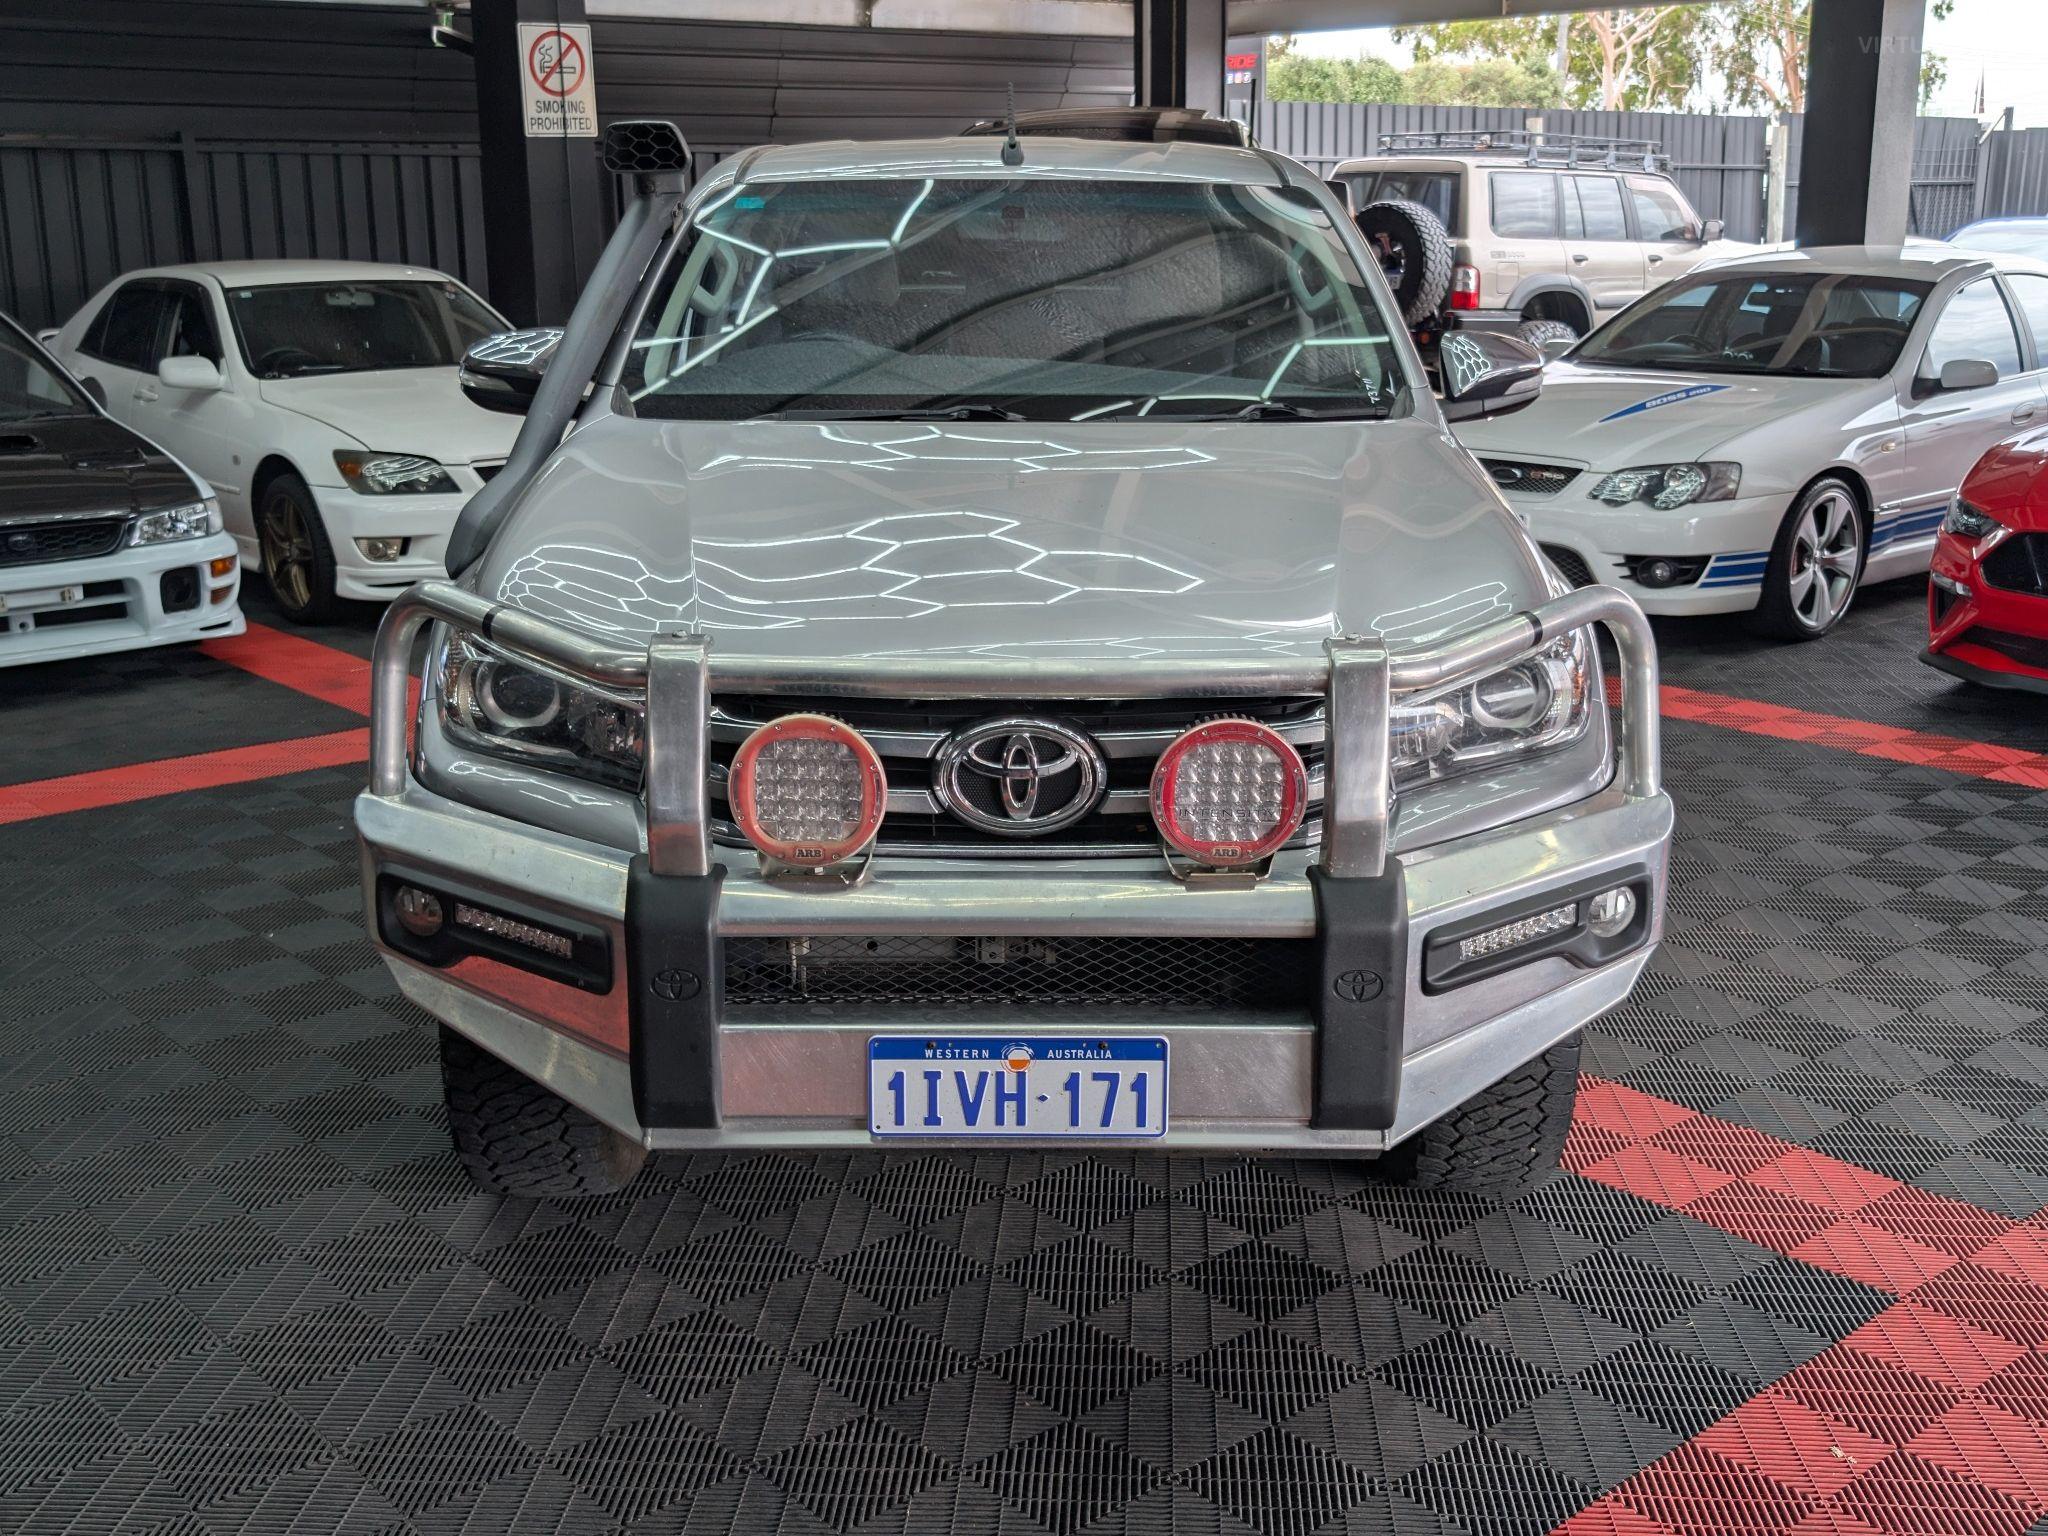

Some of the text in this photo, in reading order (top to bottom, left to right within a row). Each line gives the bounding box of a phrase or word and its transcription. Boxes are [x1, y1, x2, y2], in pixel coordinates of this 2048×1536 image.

[535, 100, 586, 114] SMOKING
[529, 117, 593, 131] PROHIBITED
[1645, 391, 1687, 409] BOSS
[797, 848, 823, 858] ARB
[1213, 848, 1239, 858] ARB
[924, 1048, 1113, 1059] WESTERN AUSTRALIA
